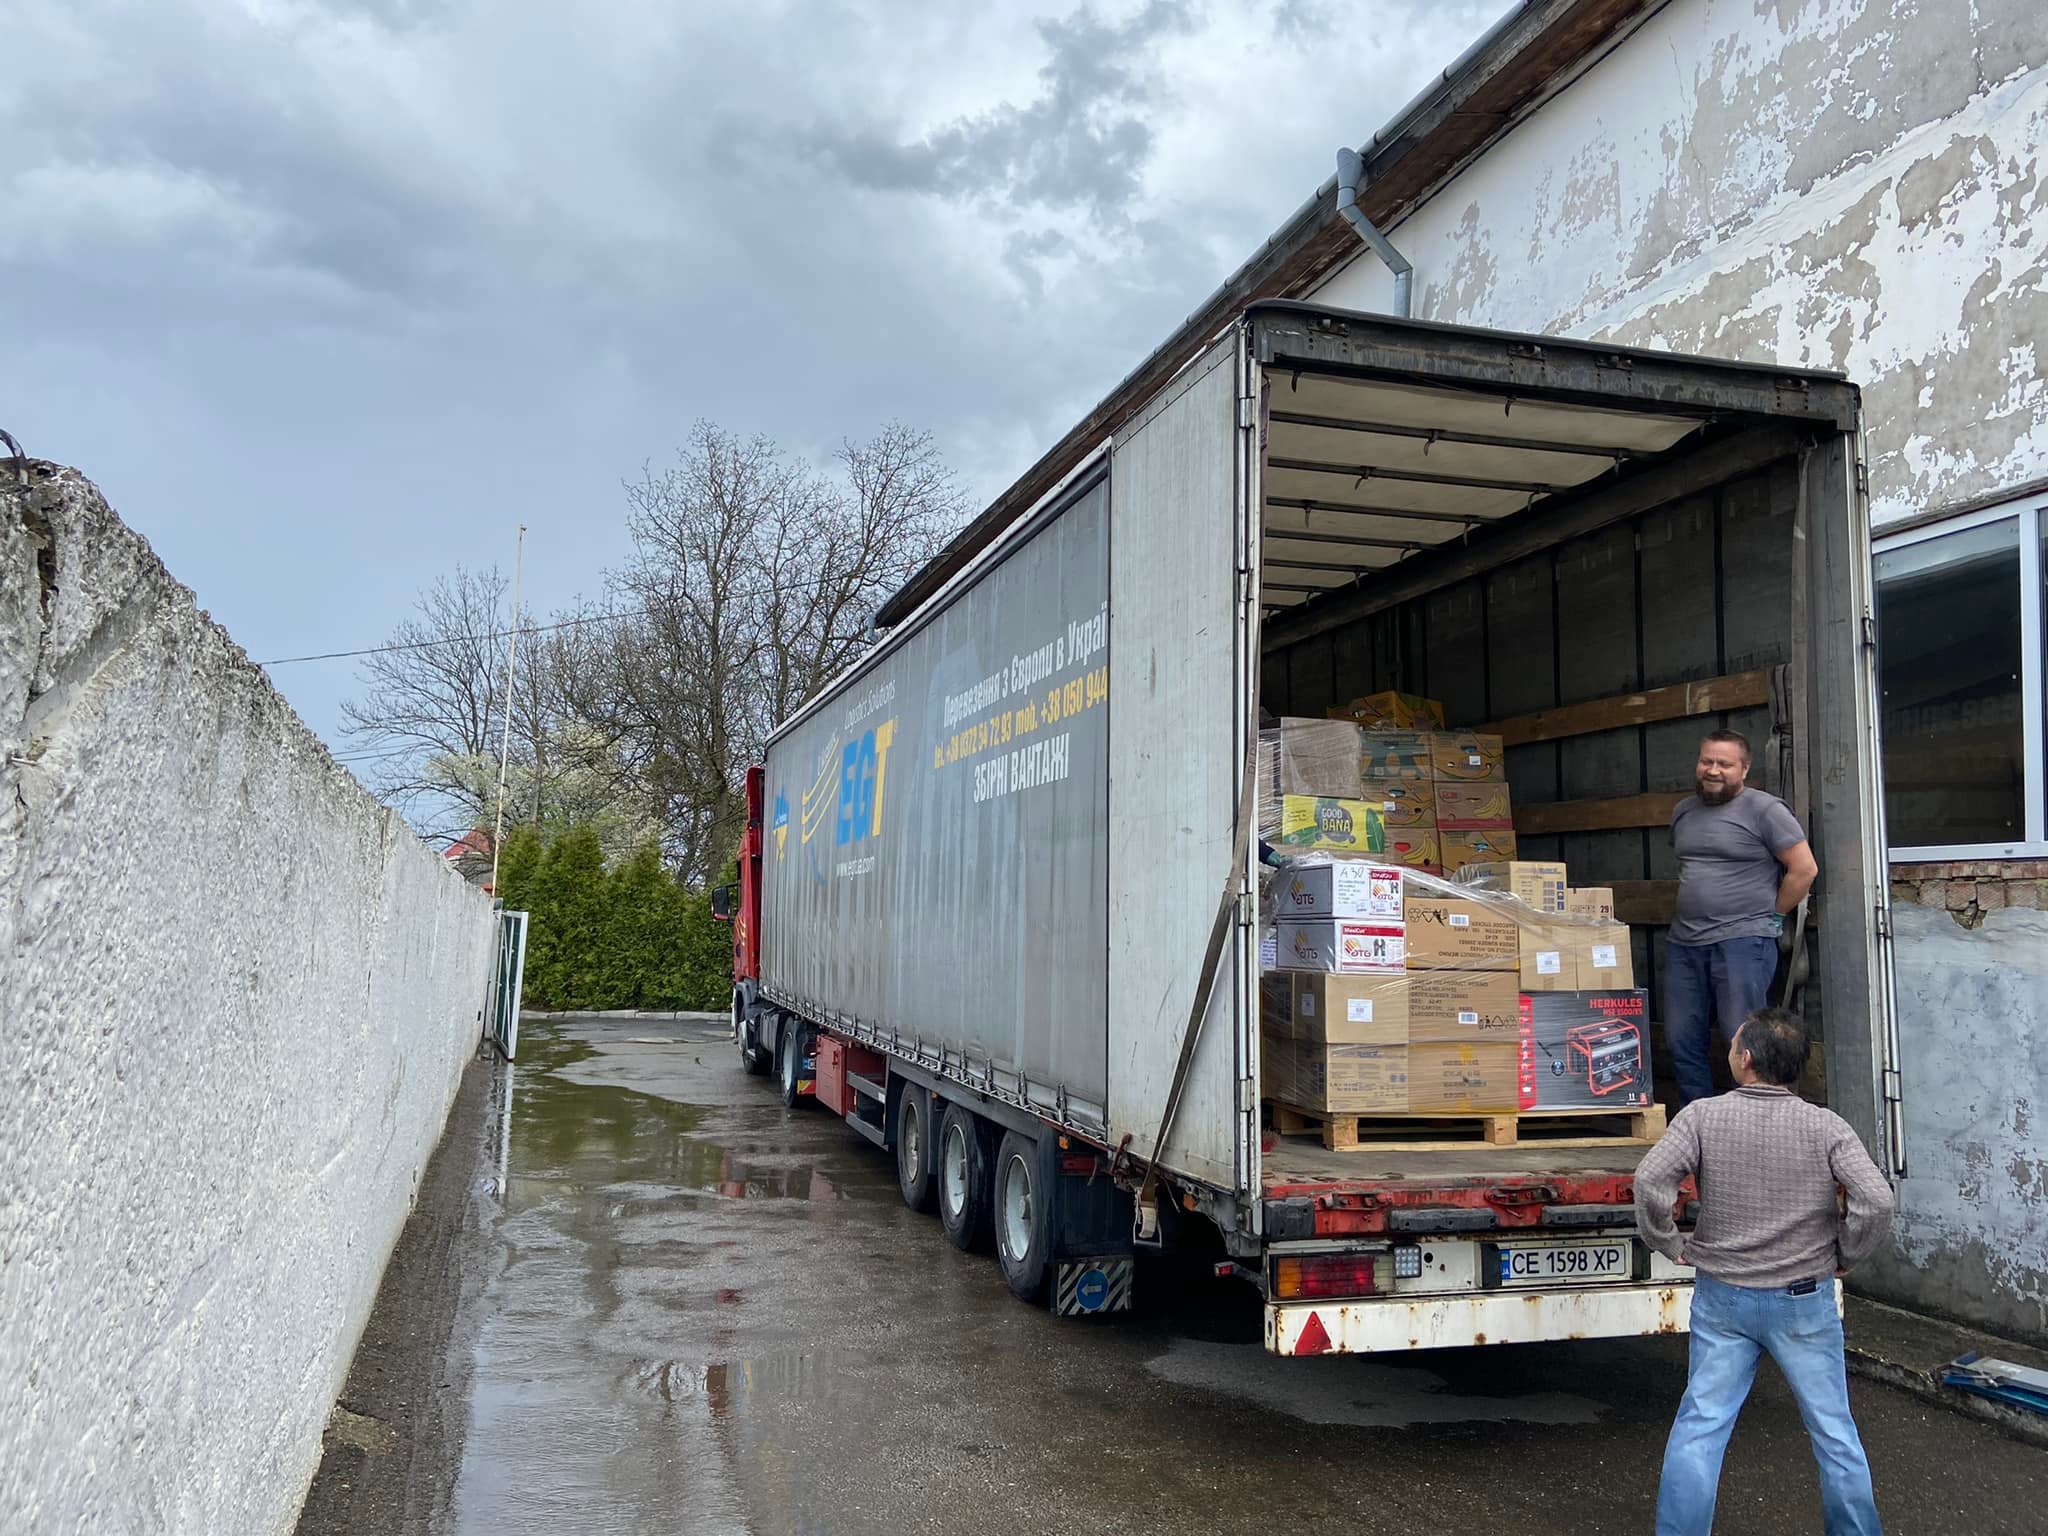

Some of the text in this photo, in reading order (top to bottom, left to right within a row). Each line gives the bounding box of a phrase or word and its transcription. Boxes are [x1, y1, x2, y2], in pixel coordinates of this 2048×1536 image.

[1011, 655, 1054, 695] Європи
[1067, 600, 1108, 666] Украї
[1001, 711, 1012, 743] 93
[1041, 687, 1060, 724] +38
[1063, 676, 1083, 718] 050
[1086, 665, 1108, 709] 944
[974, 731, 1070, 803] ЗБІРНІ ВАНТАЖІ
[1321, 807, 1343, 819] GOOD
[1322, 818, 1351, 832] BANA
[1590, 998, 1643, 1009] HERKULES
[1512, 1252, 1540, 1275] CE
[1546, 1250, 1588, 1273] 1598
[1593, 1248, 1620, 1271] XP
